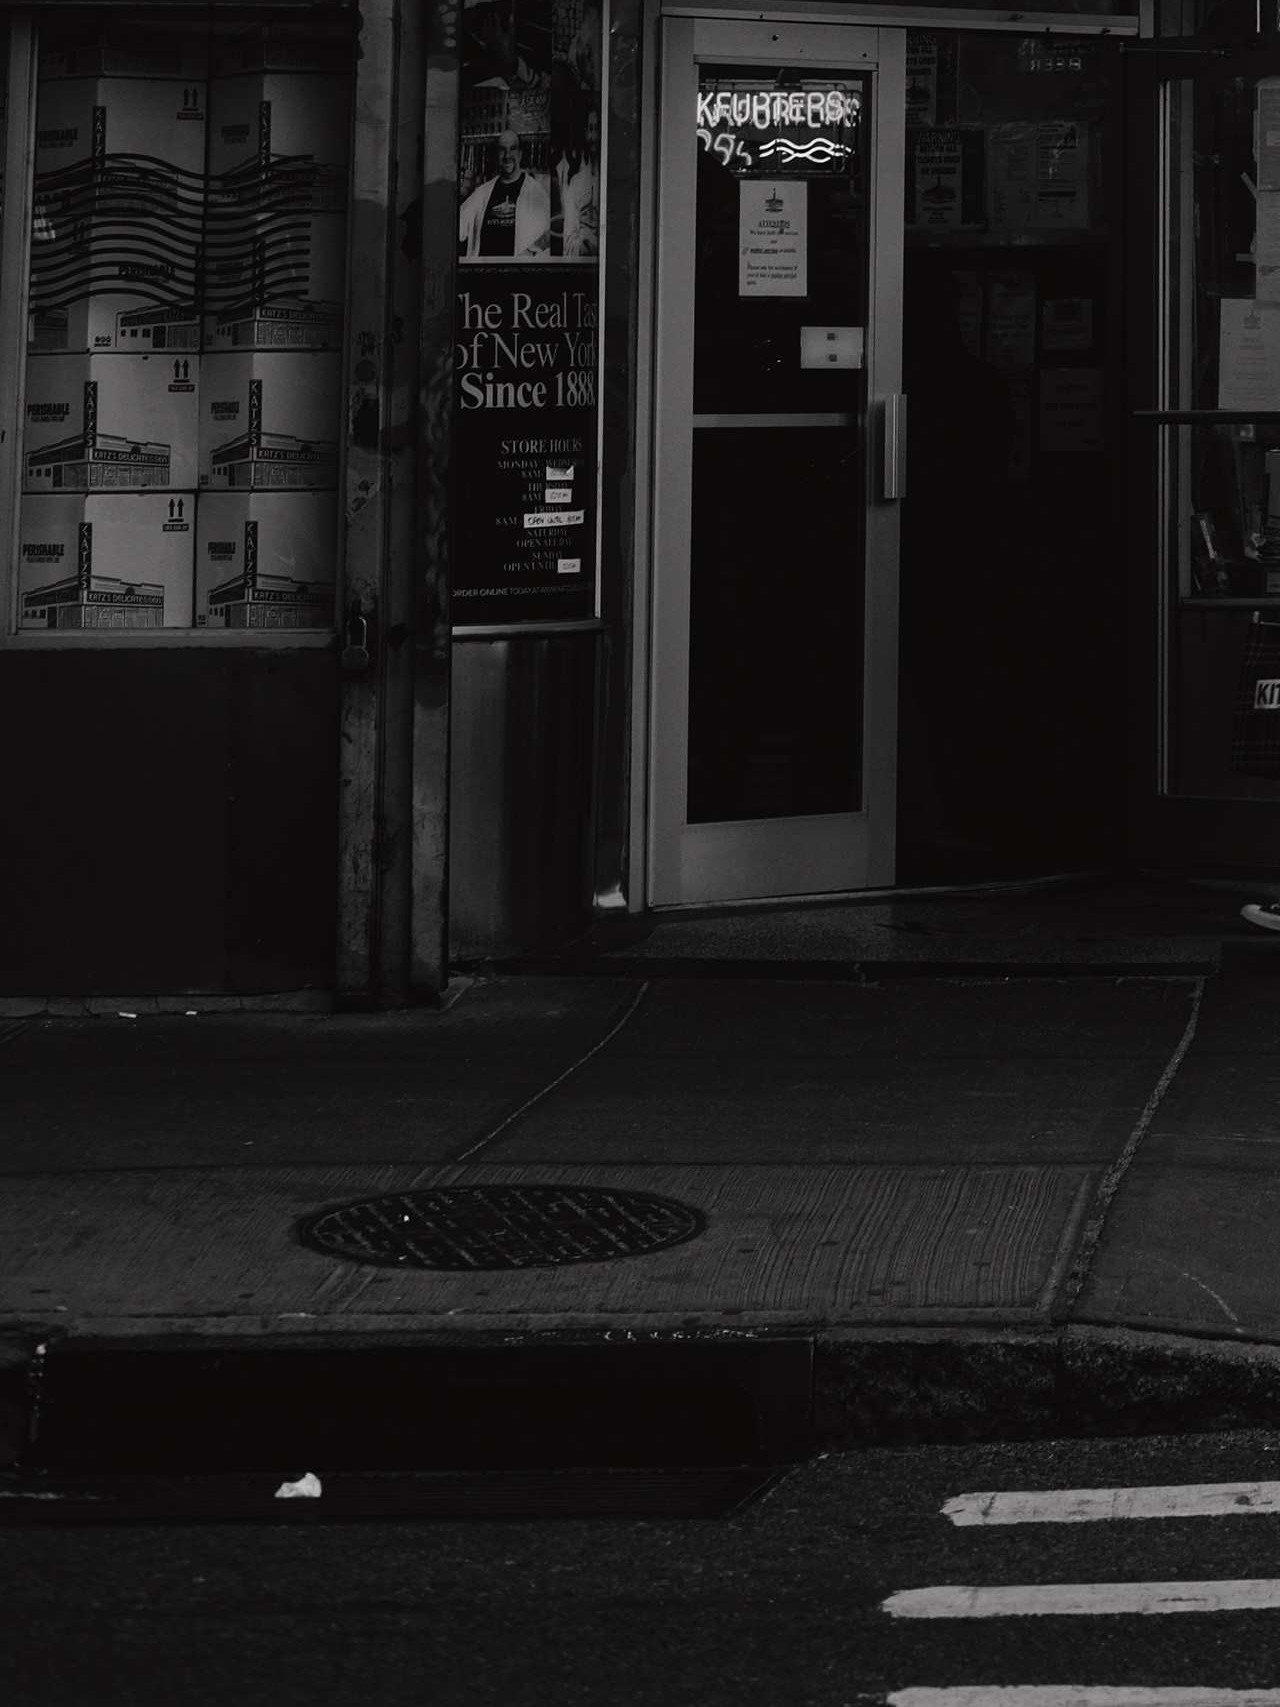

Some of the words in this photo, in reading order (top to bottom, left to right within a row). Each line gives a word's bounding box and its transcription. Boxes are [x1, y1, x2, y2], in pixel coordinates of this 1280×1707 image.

[916, 130, 961, 145] WARNING
[919, 145, 944, 153] RETURN
[946, 144, 958, 153] ALL
[916, 156, 942, 164] TICKETS
[943, 155, 961, 164] USED
[931, 167, 957, 175] UNUSED
[510, 292, 569, 329] Real
[490, 332, 560, 369] New
[460, 371, 548, 410] Since
[27, 403, 70, 416] PERISHABLE
[211, 401, 240, 414] PERISHABLE
[501, 439, 546, 455] STORE
[549, 438, 583, 453] HOURS
[498, 460, 538, 470] MONDAY
[495, 517, 518, 526] 8AM
[527, 528, 568, 538] SATURDAY
[207, 542, 236, 555] PERISHABLE
[516, 538, 541, 548] OPEN
[23, 543, 65, 556] PERISHABLE
[503, 562, 530, 572] OPEN
[479, 587, 509, 597] ONLINE
